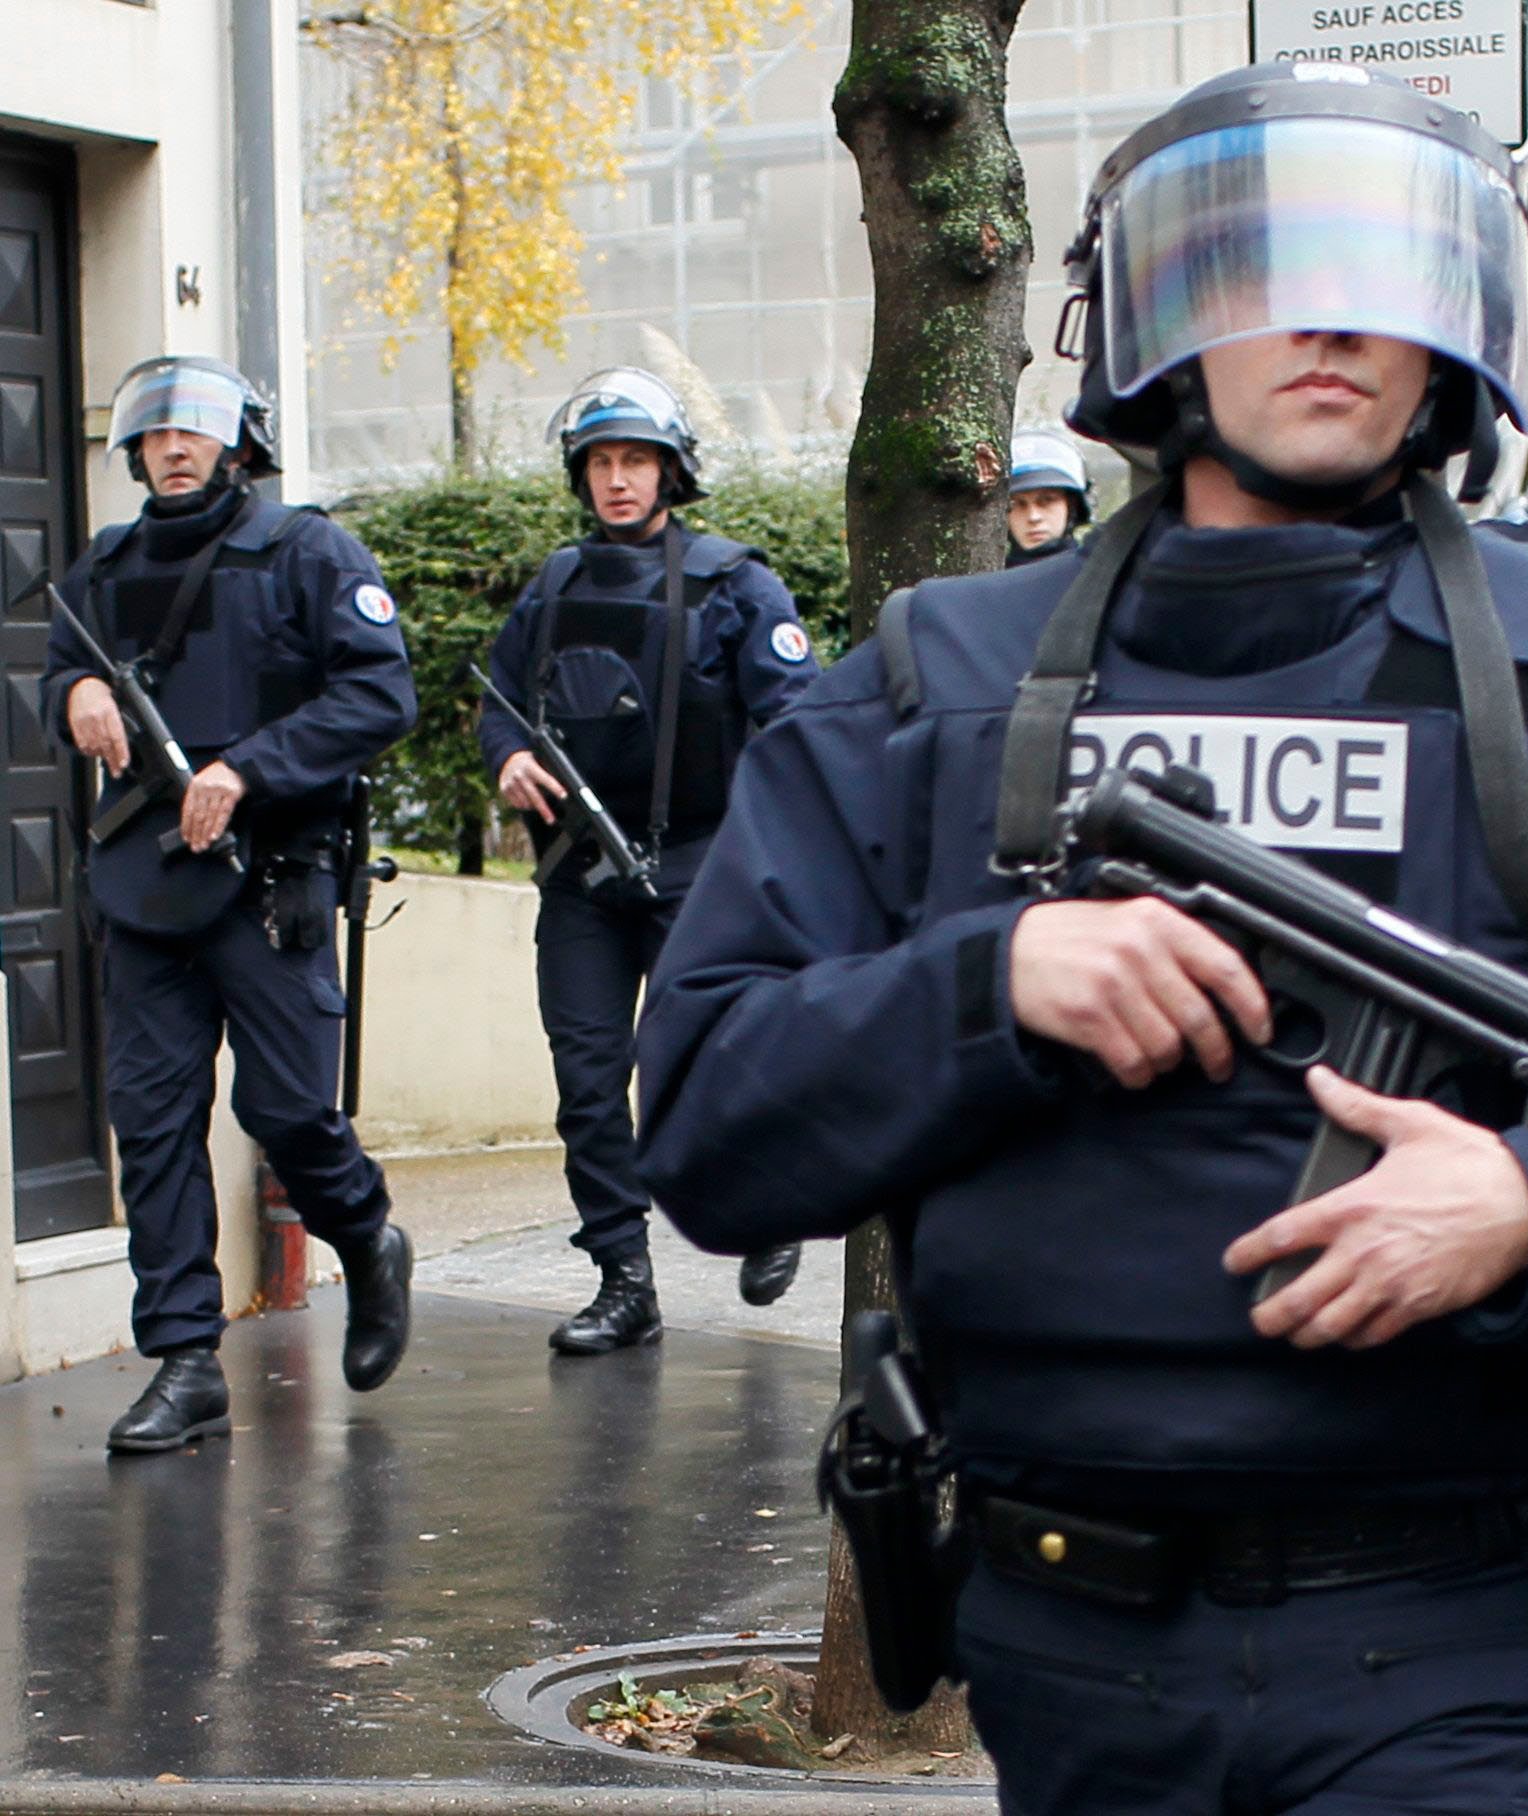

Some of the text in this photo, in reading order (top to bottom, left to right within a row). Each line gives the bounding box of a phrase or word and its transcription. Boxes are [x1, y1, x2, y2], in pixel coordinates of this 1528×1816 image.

[1313, 1, 1463, 30] SAUF ACCES
[1350, 33, 1505, 62] PAROISSIALE
[1404, 75, 1451, 95] EDI
